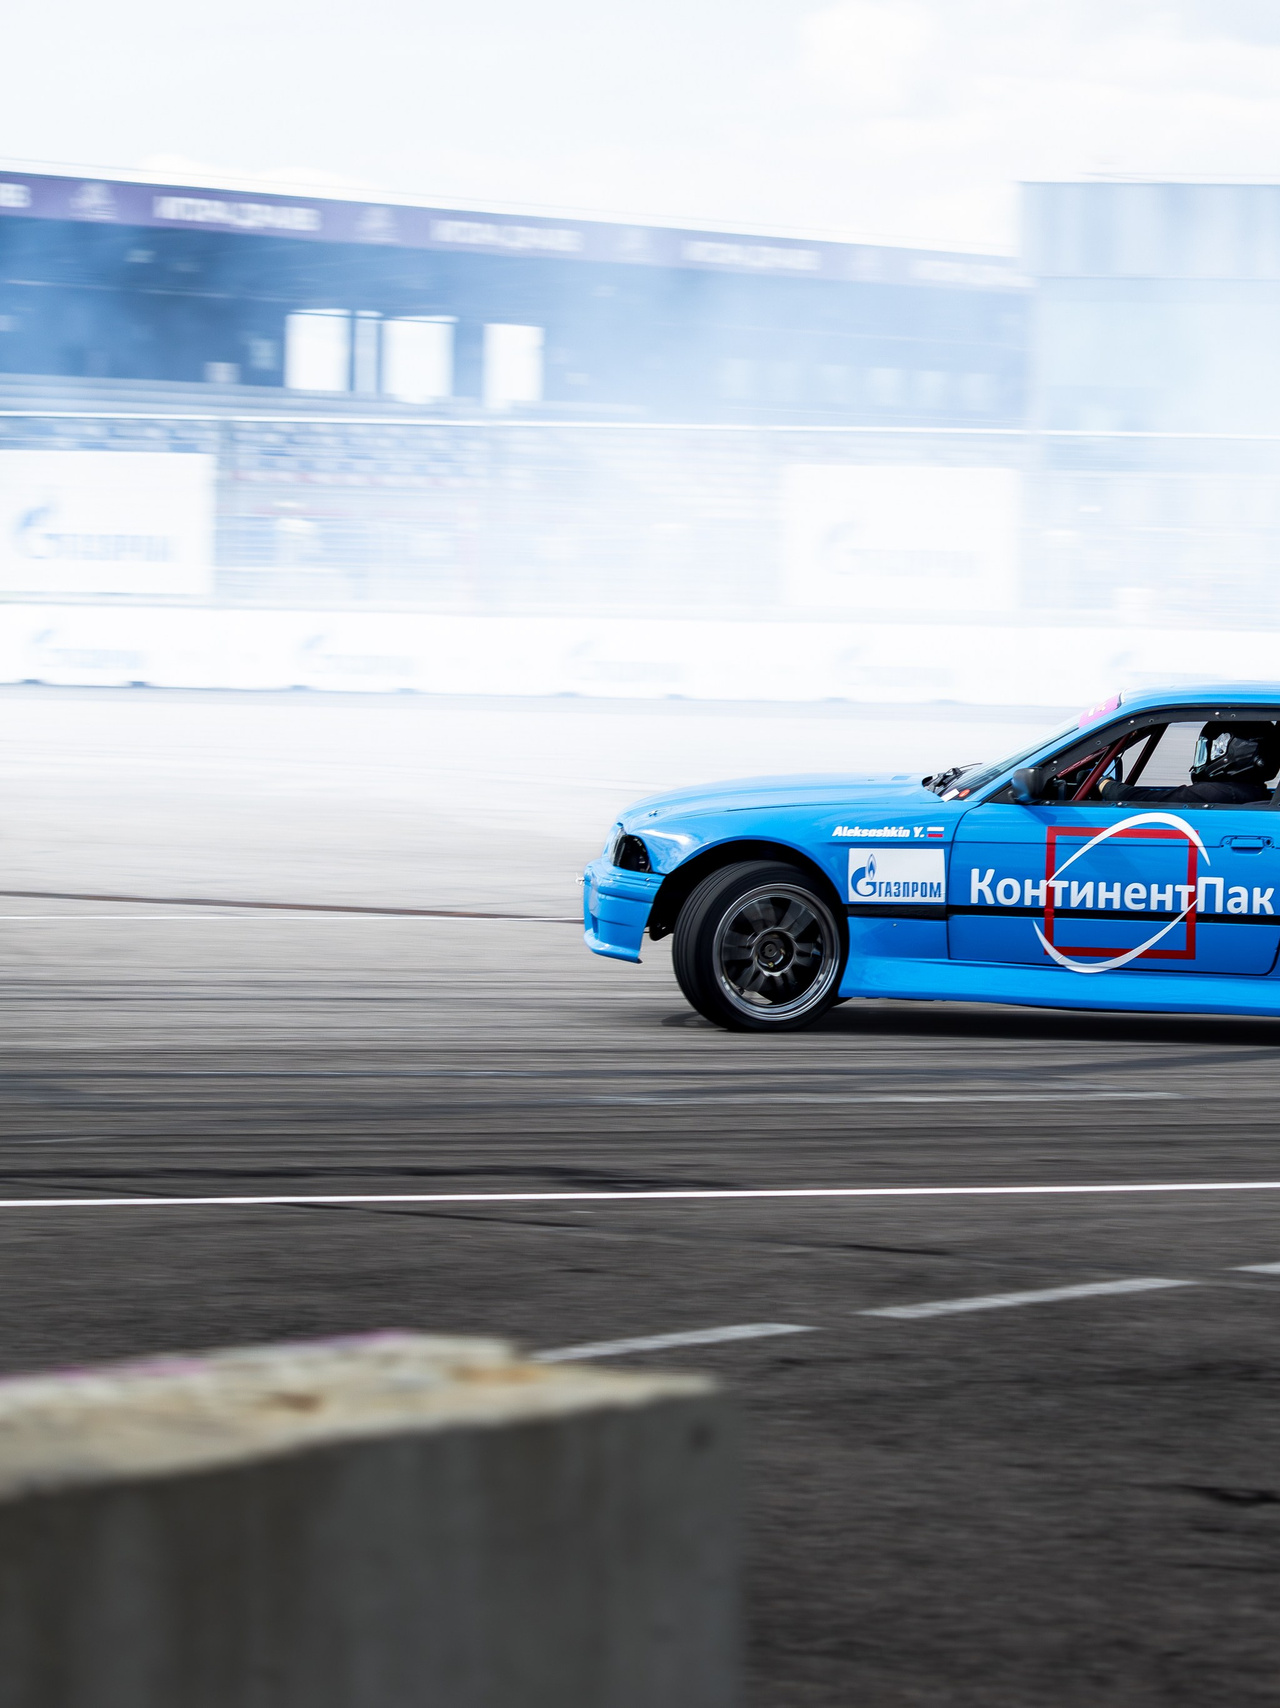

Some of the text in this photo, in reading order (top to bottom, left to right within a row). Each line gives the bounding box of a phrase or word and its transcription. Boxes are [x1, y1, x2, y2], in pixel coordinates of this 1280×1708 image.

[913, 826, 925, 838] Y.
[878, 882, 942, 898] ГАЗПРОМ
[970, 868, 1275, 915] КонтинентПак
